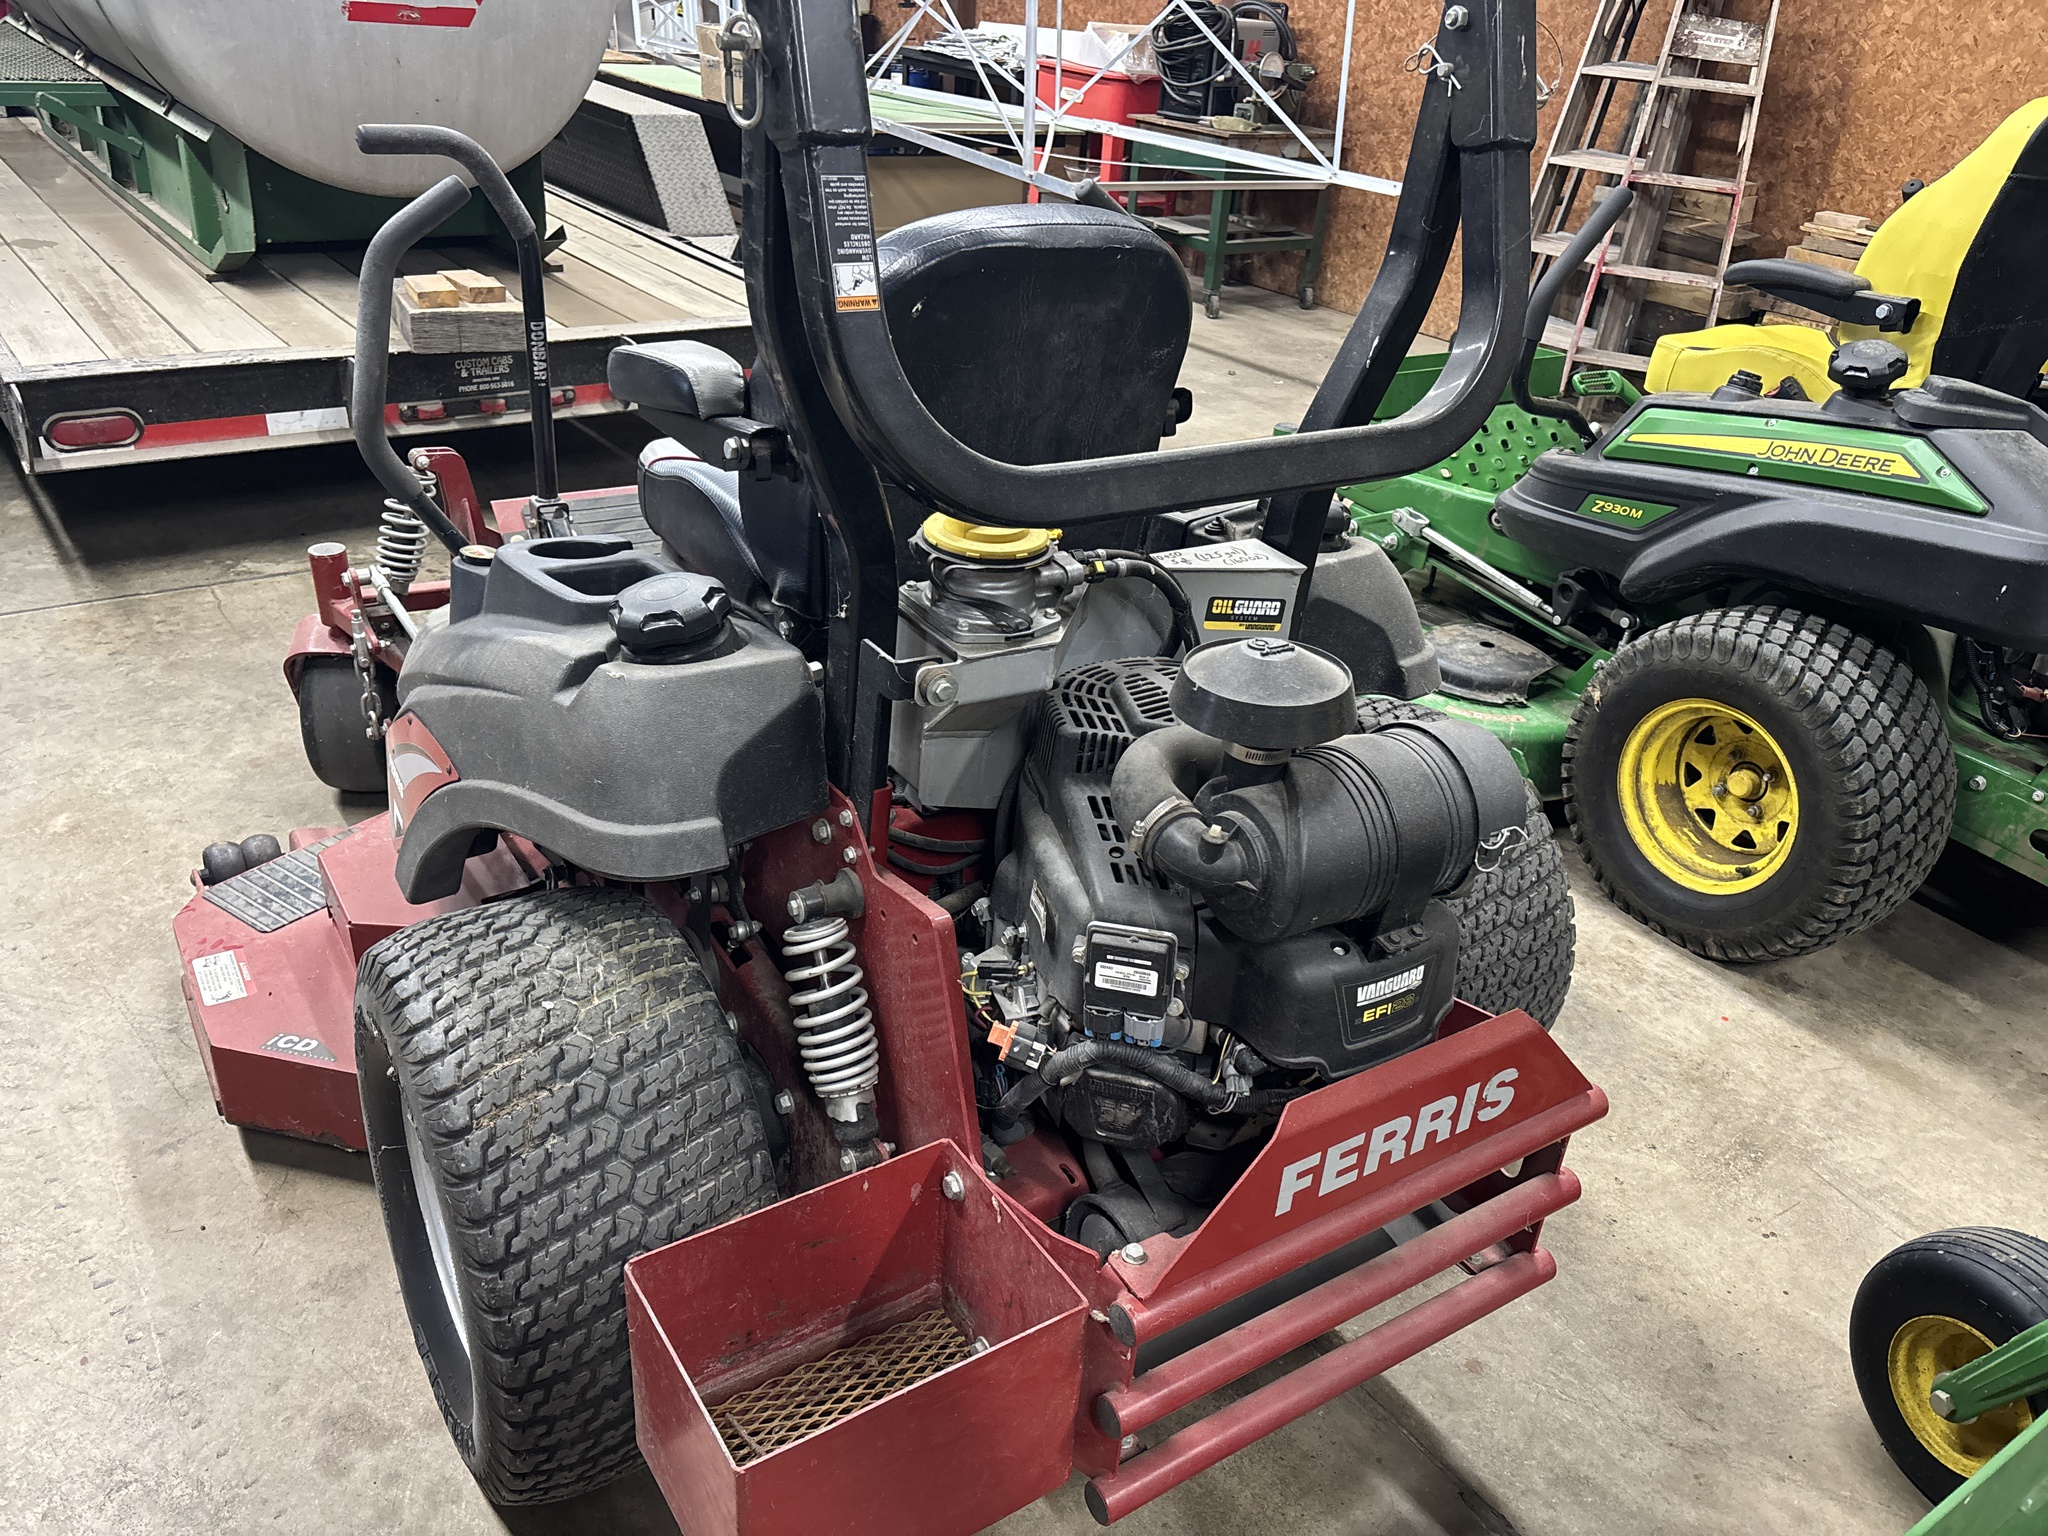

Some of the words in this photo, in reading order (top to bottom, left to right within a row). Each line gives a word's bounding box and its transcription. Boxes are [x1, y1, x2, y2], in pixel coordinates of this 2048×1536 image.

[838, 300, 872, 308] WARNING
[530, 322, 547, 380] DONBAR
[455, 358, 490, 369] CUSTOM
[491, 355, 514, 365] CABS
[461, 369, 468, 377] &
[471, 364, 510, 376] TRAILERS
[459, 384, 478, 392] PHONE
[1757, 440, 1817, 464] JOHN
[1818, 448, 1896, 473] DEERE
[1590, 500, 1644, 520] Z930M
[1212, 600, 1281, 616] OILGUARD
[1356, 965, 1424, 1003] VANGUARD
[1274, 1068, 1520, 1218] FERRIS
